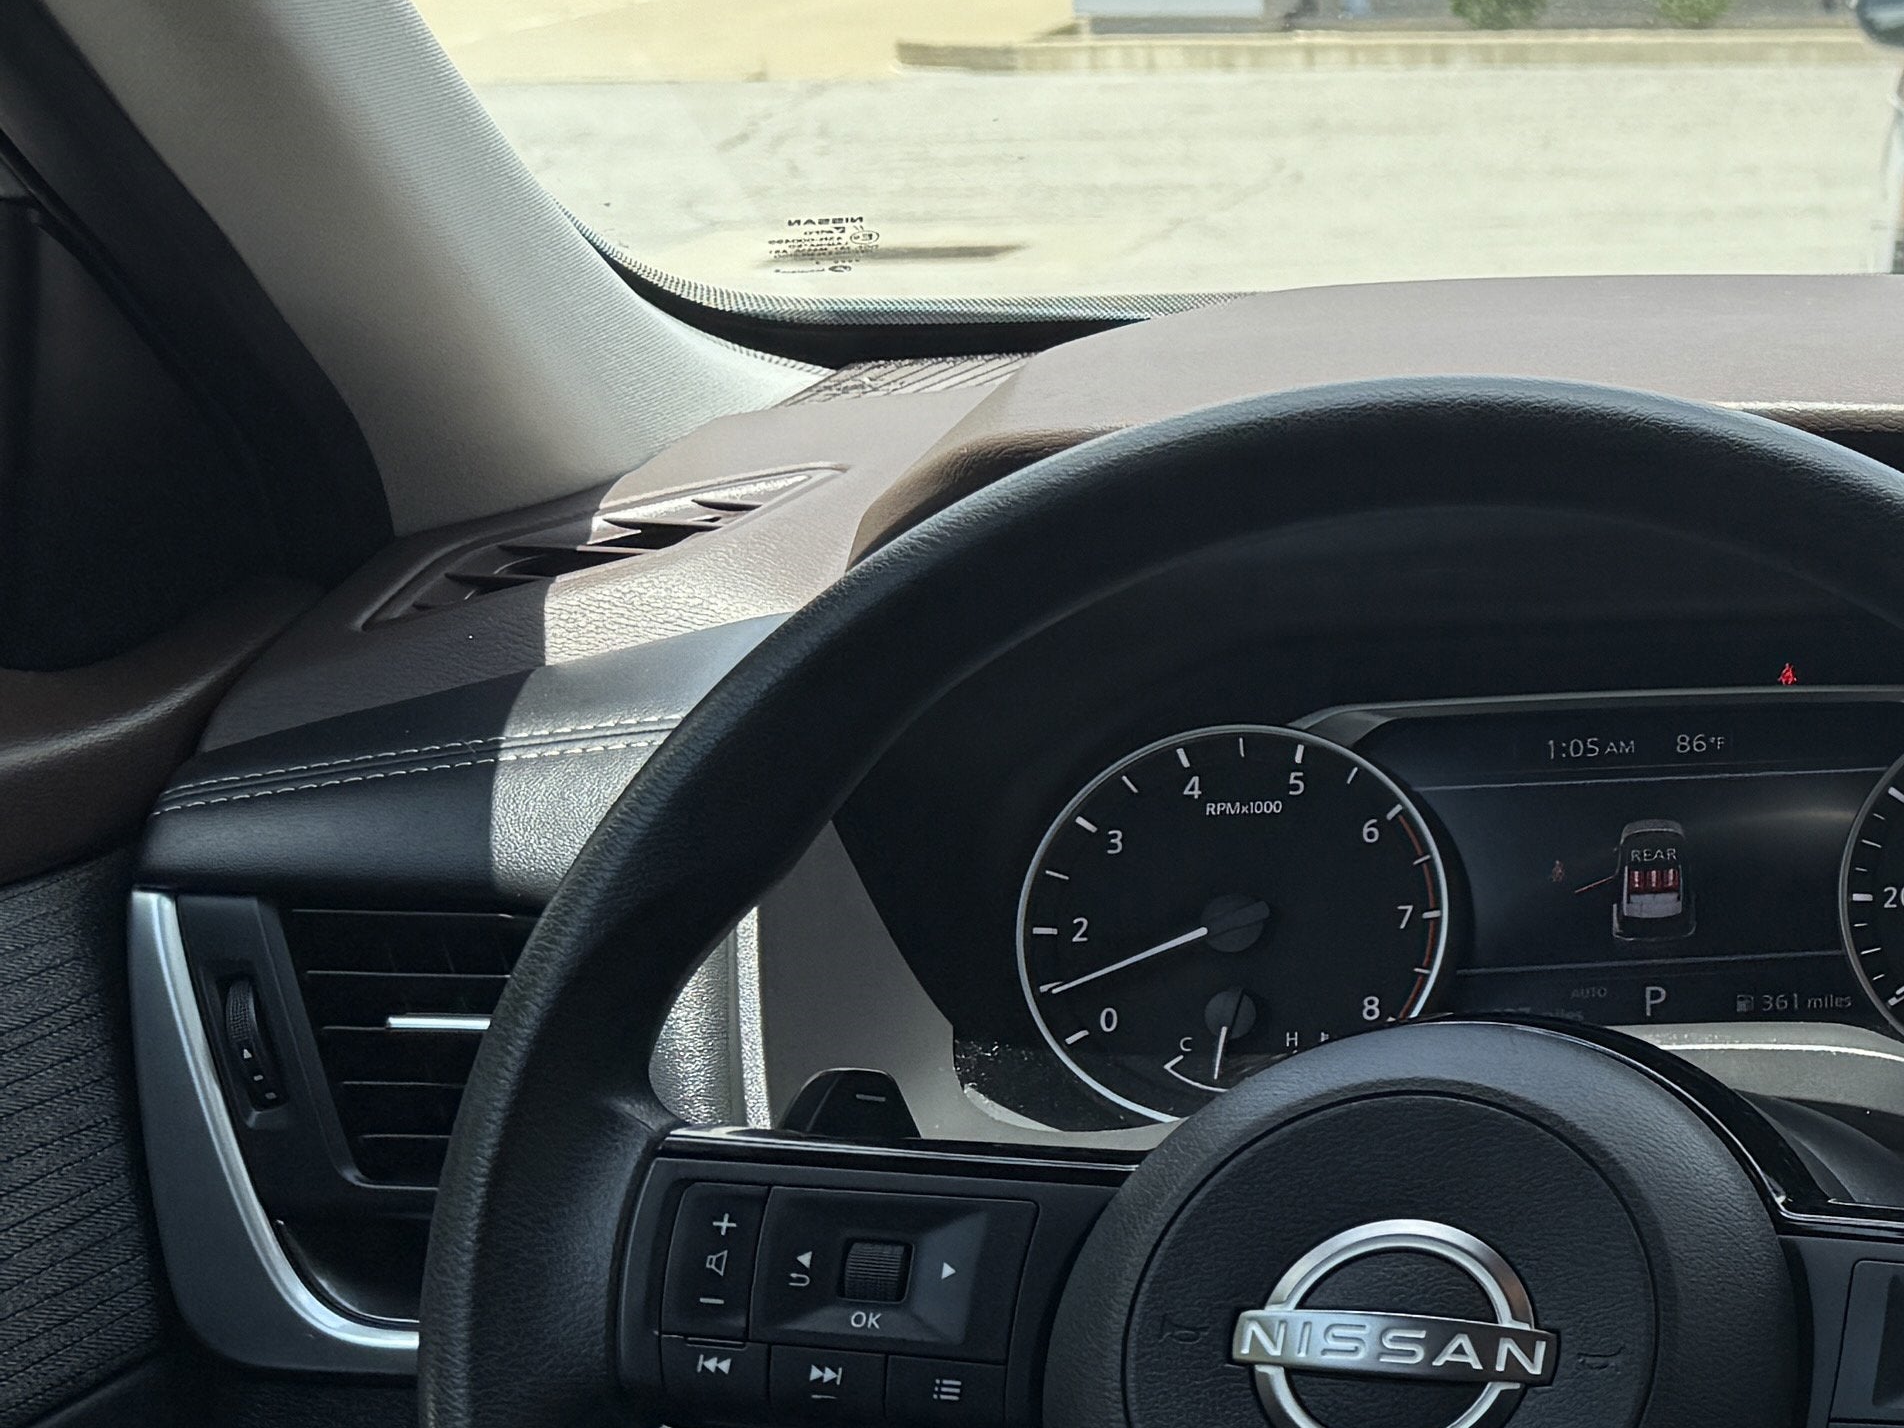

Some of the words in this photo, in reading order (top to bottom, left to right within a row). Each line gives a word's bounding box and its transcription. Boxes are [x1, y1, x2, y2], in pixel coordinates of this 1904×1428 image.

[1547, 737, 1600, 759] 1:05
[1604, 740, 1635, 755] AM
[1183, 775, 1202, 798] 4
[1289, 772, 1305, 795] 5
[1205, 800, 1283, 816] RPMx1000
[1107, 830, 1124, 854] 3
[1362, 821, 1379, 843] 6
[1630, 848, 1677, 862] REAR
[1398, 905, 1414, 928] 7
[1072, 918, 1089, 942] 2
[1362, 997, 1380, 1020] 8
[1645, 986, 1667, 1016] P
[1762, 993, 1799, 1012] 361
[1807, 993, 1852, 1010] miles
[1100, 1008, 1118, 1032] 0
[1179, 1036, 1192, 1052] C
[1286, 1032, 1298, 1047] H
[851, 1310, 882, 1330] OK
[1240, 1318, 1548, 1377] NISSAN
